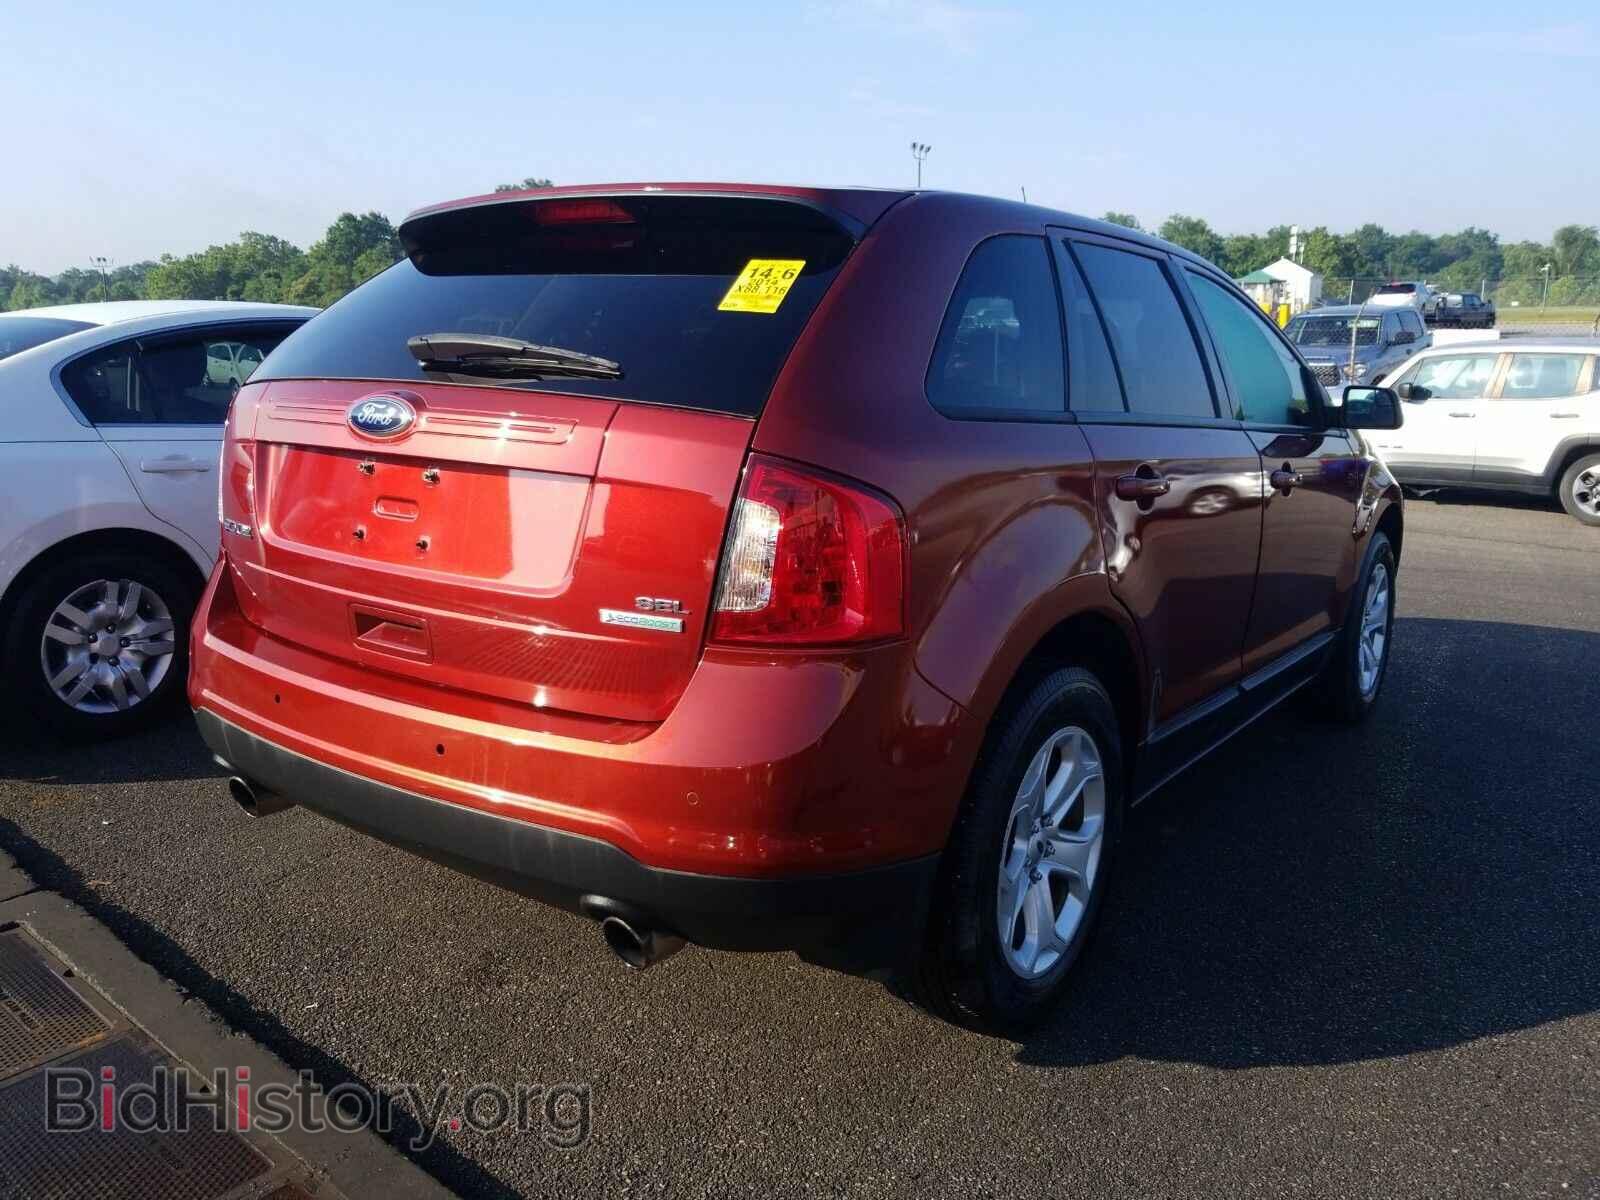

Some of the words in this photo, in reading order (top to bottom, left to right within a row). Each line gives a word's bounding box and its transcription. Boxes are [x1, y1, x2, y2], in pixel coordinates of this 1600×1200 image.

[749, 279, 779, 288] 2014
[357, 402, 393, 425] Ford
[634, 596, 691, 615] SEL
